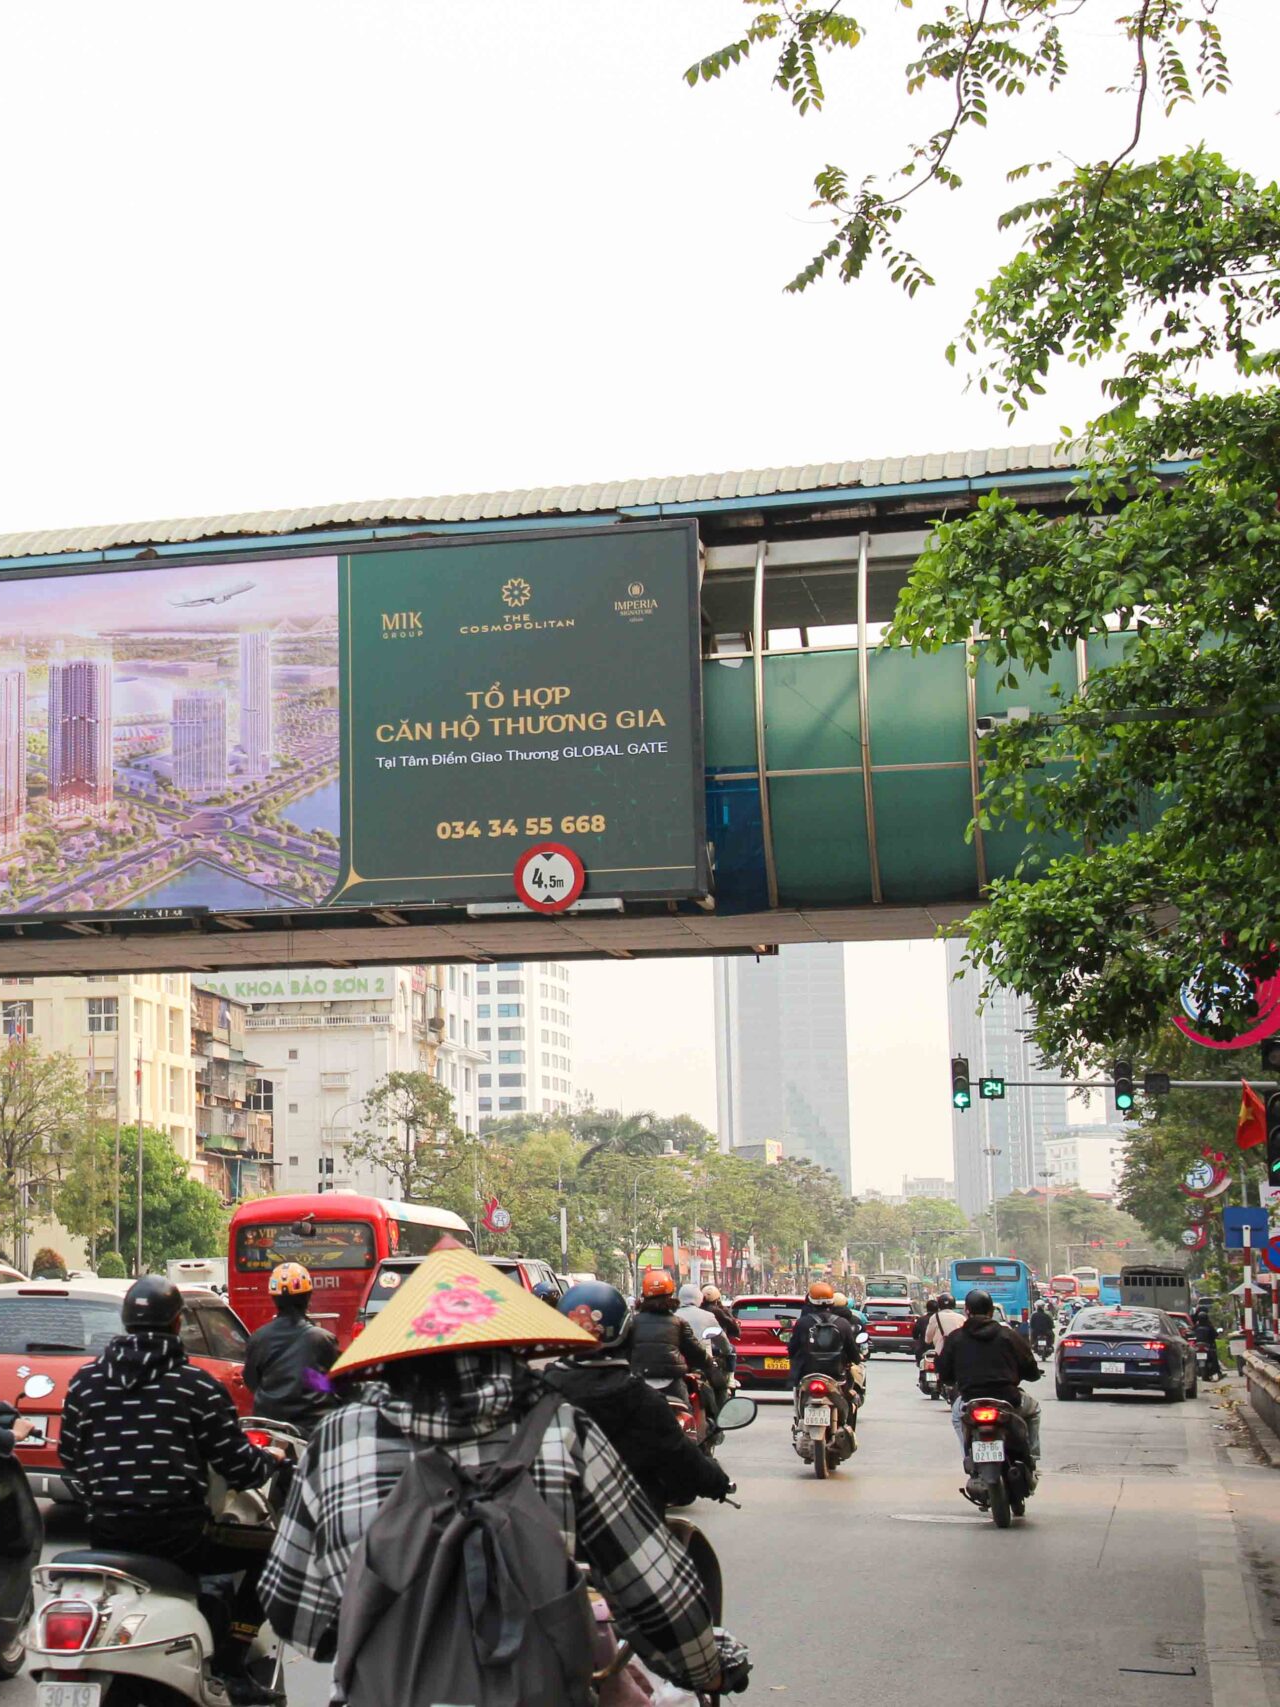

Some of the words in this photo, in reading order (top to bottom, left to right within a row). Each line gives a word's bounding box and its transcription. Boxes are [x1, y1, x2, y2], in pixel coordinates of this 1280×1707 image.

[614, 599, 658, 611] IMPERIA
[382, 611, 423, 630] MIK
[459, 619, 575, 634] COSMOPOLITAN
[504, 614, 530, 622] THE
[382, 631, 424, 640] GROUP
[465, 681, 505, 710] TỔ
[512, 686, 571, 710] HỢP
[375, 718, 433, 743] CĂN
[440, 715, 480, 742] HỘ
[488, 711, 608, 737] THƯƠNG
[615, 708, 667, 729] GIA
[375, 756, 396, 770] Tại
[399, 754, 429, 768] Tâm
[432, 751, 467, 765] Điểm
[470, 750, 503, 764] Giao
[505, 747, 559, 763] Thương
[562, 744, 624, 758] GLOBAL
[627, 741, 668, 754] GATE
[436, 820, 481, 839] 034
[488, 818, 518, 837] 34
[525, 816, 553, 836] 55
[560, 815, 606, 834] 668
[235, 981, 285, 998] KHOA
[291, 975, 327, 996] BẢO
[333, 976, 369, 995] SƠN
[375, 977, 385, 993] 2
[984, 1081, 1002, 1096] 24
[258, 1228, 277, 1239] VIP
